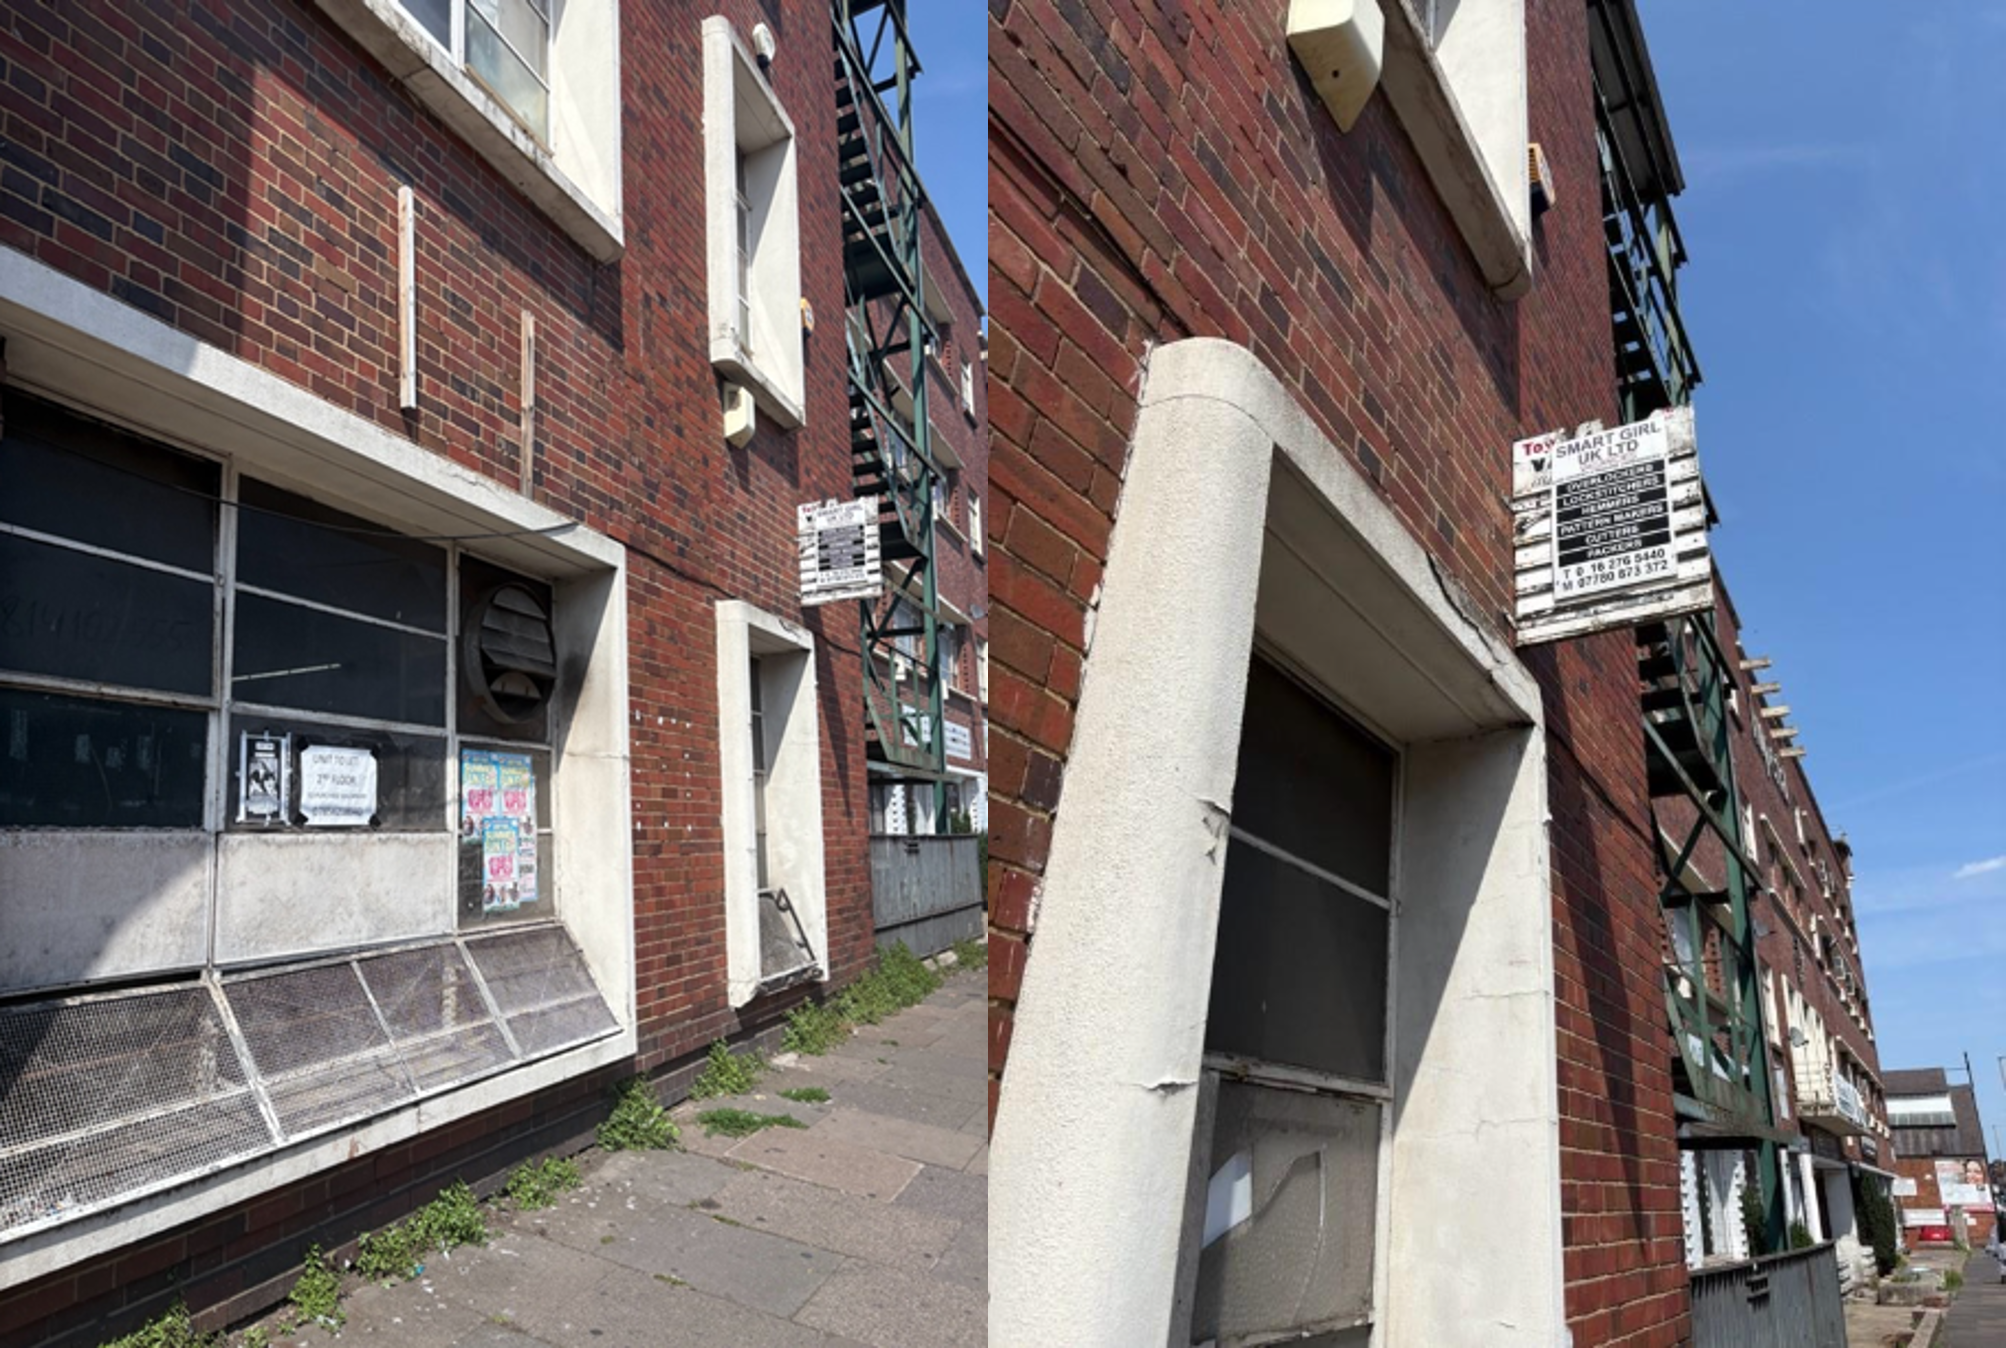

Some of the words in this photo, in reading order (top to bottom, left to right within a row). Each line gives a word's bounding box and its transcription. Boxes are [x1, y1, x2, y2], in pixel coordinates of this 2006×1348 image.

[1556, 433, 1615, 458] SMART
[1619, 421, 1662, 440] GIRL
[1578, 448, 1601, 465] UK
[1608, 439, 1639, 456] LTD
[1563, 475, 1660, 506] LOCKSTITCHERS
[1567, 463, 1653, 492] OVERLOCKERS
[1581, 496, 1640, 515] HEMMERS
[1561, 517, 1612, 535] PATTERN
[1613, 504, 1663, 522] MAKERS
[1585, 525, 1639, 545] CUTTERS
[1586, 539, 1642, 558] PACKERS
